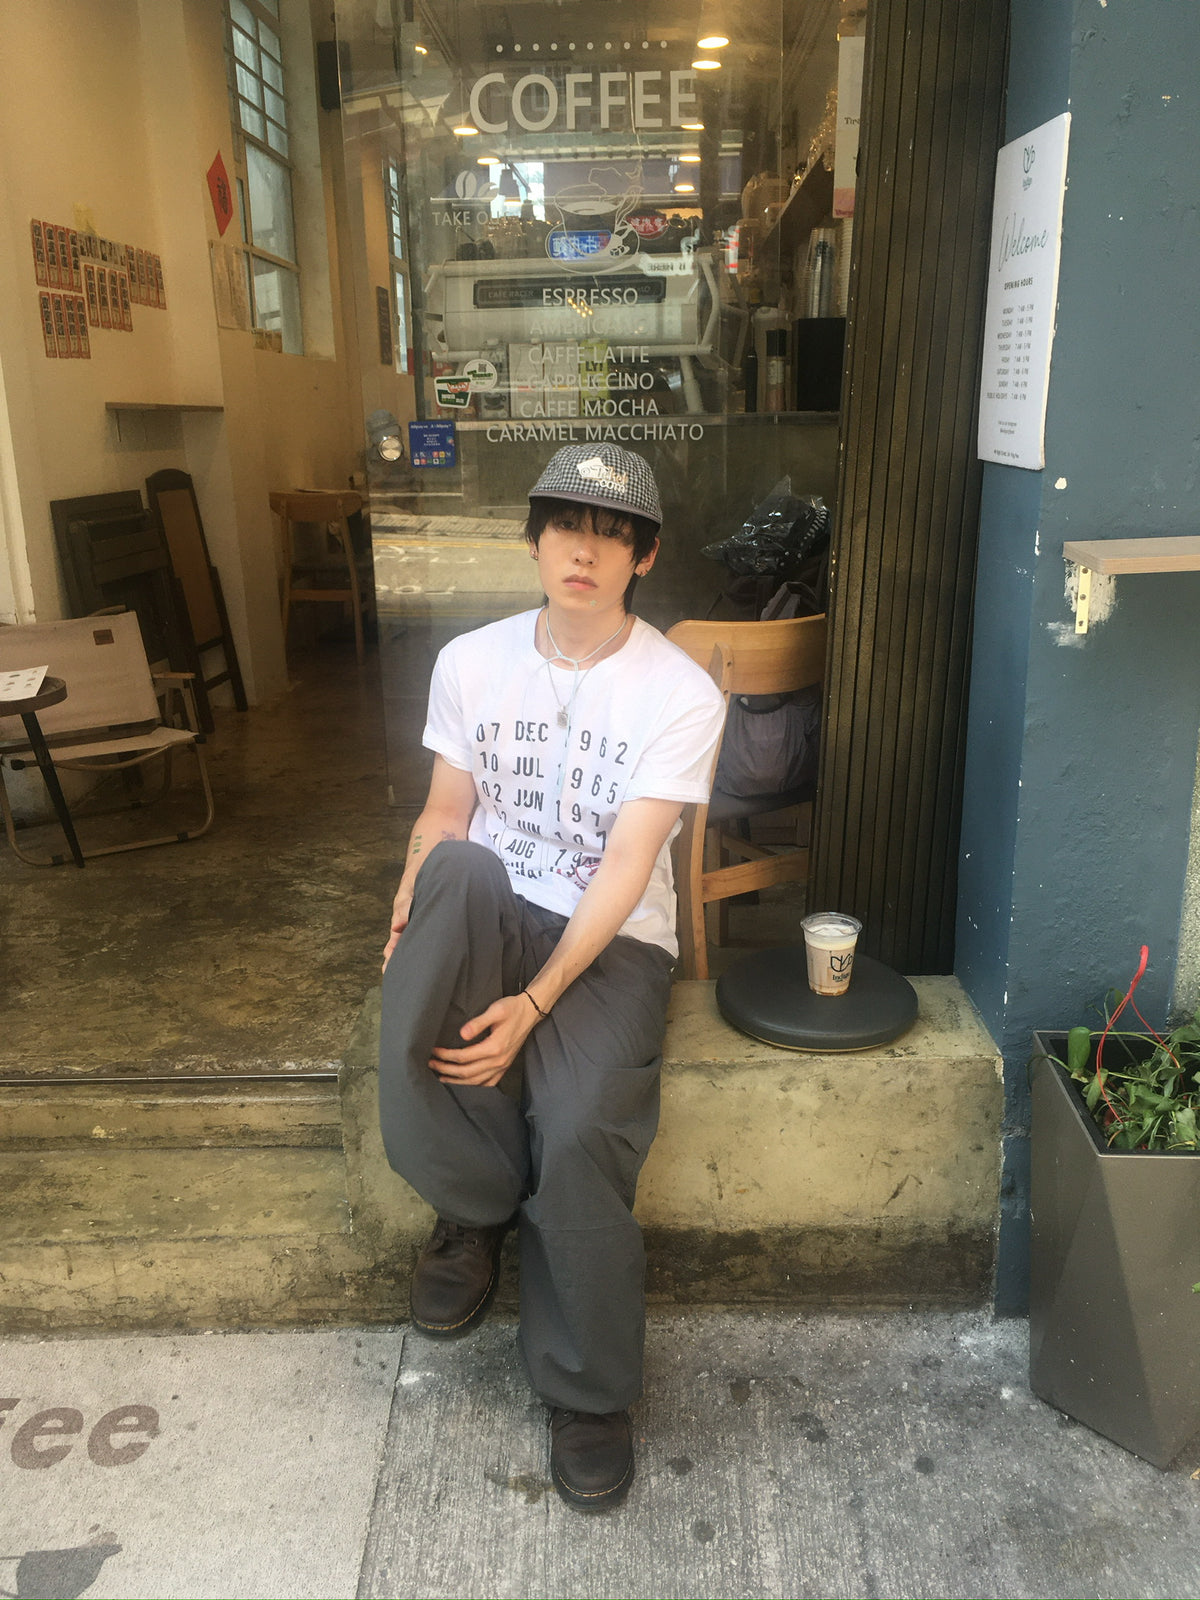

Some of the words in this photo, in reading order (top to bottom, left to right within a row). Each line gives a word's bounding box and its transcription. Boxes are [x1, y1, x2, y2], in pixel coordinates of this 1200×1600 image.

[470, 70, 699, 133] COFFEE
[432, 211, 471, 226] TAKE
[999, 213, 1047, 272] Welcome
[542, 287, 638, 307] ESPRESSO
[528, 346, 585, 364] CAFFE
[593, 345, 650, 363] LATTE
[527, 372, 655, 391] CAPPUCCINO
[520, 401, 577, 418] CAFFE
[584, 399, 659, 417] MOCHA
[486, 424, 578, 442] CARAMEL
[585, 423, 704, 442] MACCHIATO
[476, 722, 501, 743] 07
[514, 720, 549, 743] DEC
[480, 751, 499, 773] 10
[512, 756, 544, 779] JUL
[513, 788, 544, 812] JUN
[505, 838, 536, 859] AUG
